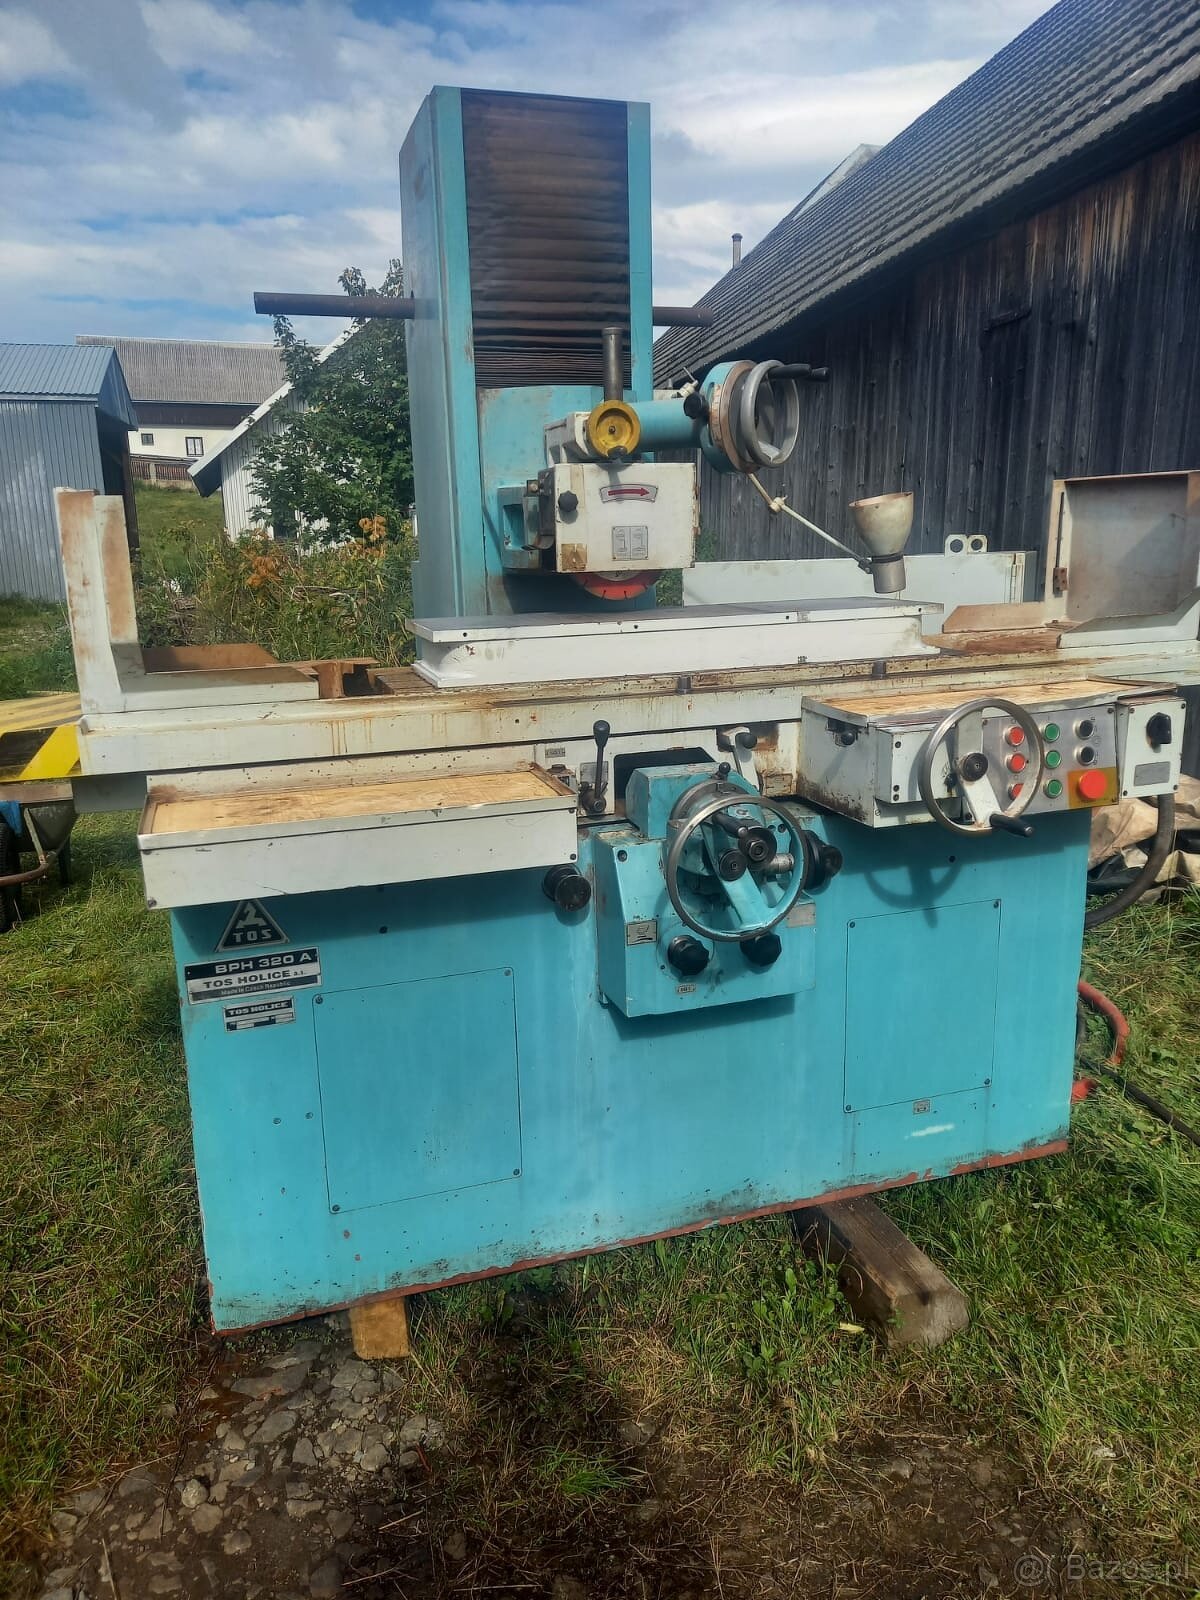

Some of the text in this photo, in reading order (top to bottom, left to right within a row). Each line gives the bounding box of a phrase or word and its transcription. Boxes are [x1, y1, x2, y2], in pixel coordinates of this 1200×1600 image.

[233, 929, 272, 942] TOS
[215, 952, 312, 974] BPH 320 A
[203, 978, 233, 989] TOS
[237, 970, 291, 984] HOLICE
[228, 1008, 249, 1016] TOS
